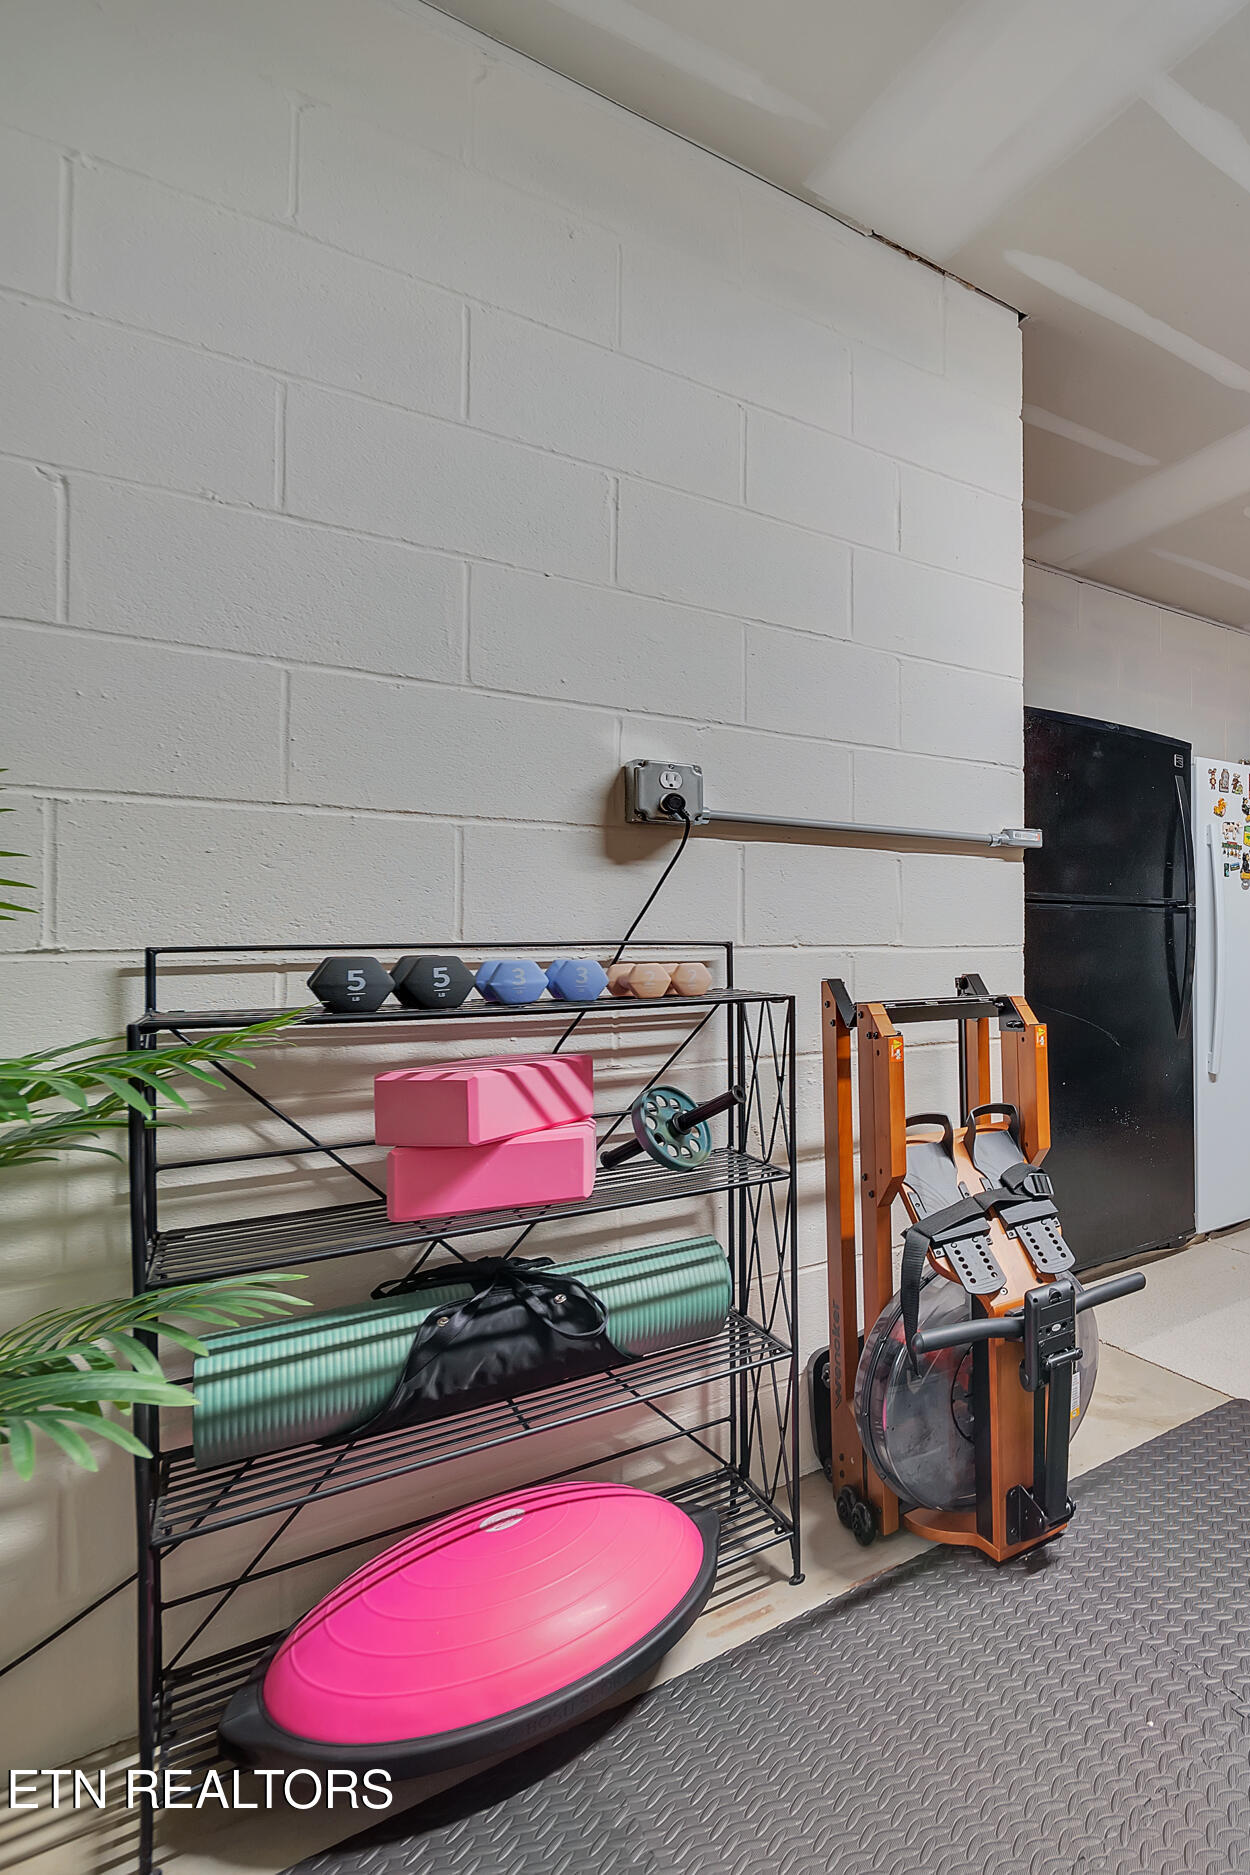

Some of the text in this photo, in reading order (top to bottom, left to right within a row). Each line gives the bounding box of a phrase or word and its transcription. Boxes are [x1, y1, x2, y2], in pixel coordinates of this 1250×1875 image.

[347, 969, 366, 991] 5
[433, 967, 451, 988] 5
[512, 967, 526, 986] 3
[575, 966, 589, 985] 3
[688, 969, 697, 982] 2
